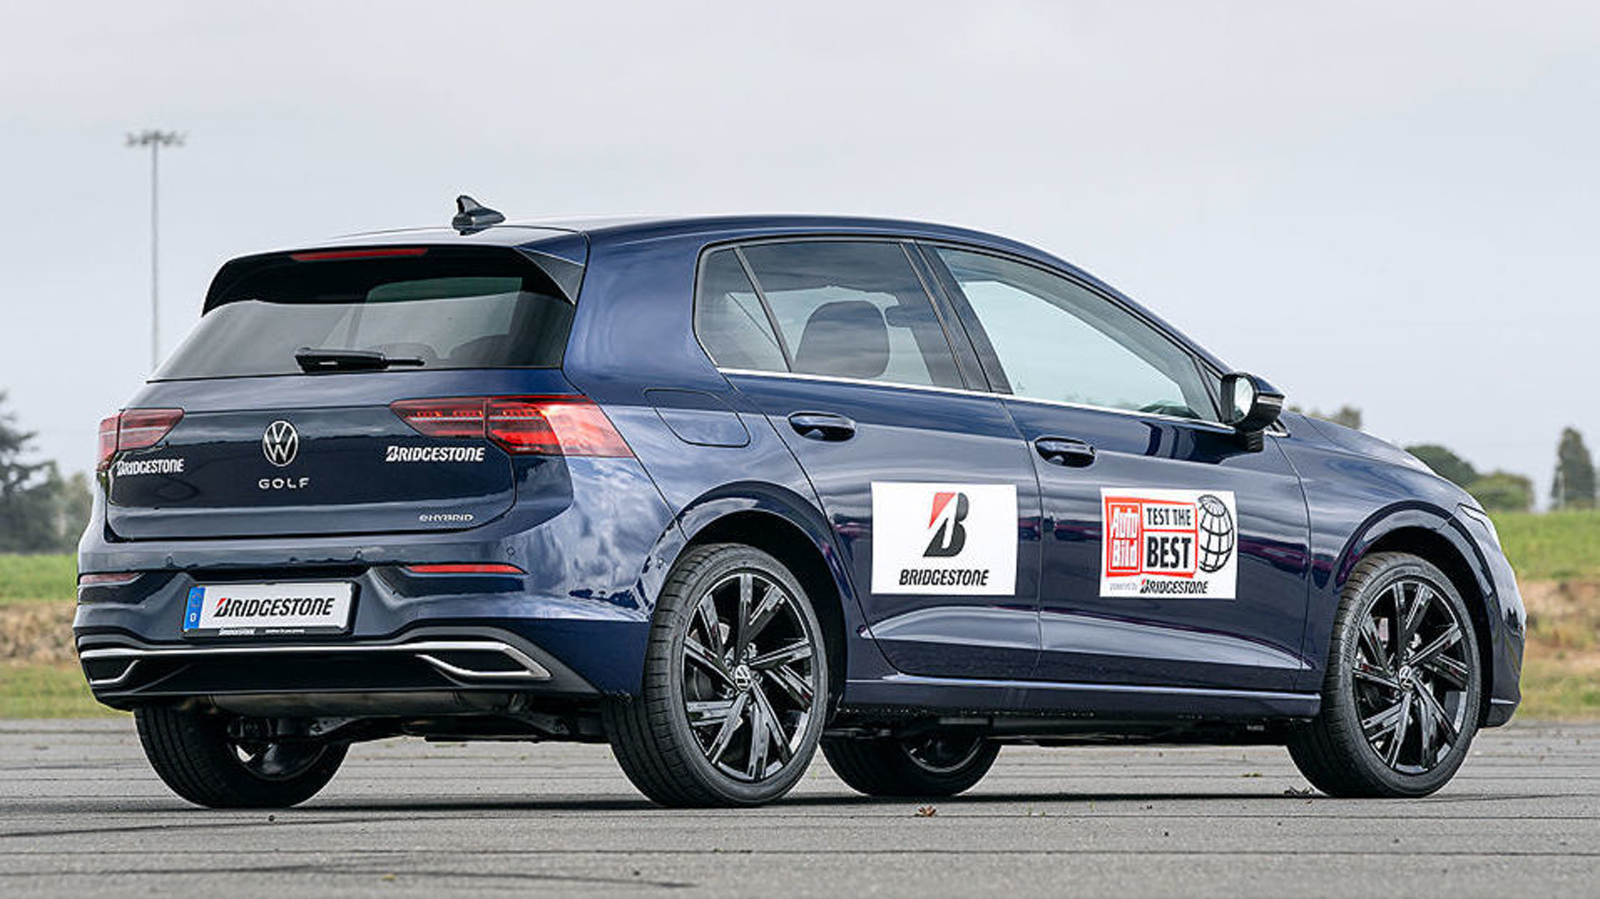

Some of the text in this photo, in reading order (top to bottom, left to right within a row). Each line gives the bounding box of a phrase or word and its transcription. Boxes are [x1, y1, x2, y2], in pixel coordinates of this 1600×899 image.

[385, 445, 485, 462] BRIDGESTONE
[116, 458, 185, 476] BRIDGESTONE
[258, 477, 310, 490] GOLF
[1146, 507, 1191, 526] TEST THE
[1146, 536, 1192, 569] BEST
[899, 569, 990, 586] BRIDGESTONE
[1140, 579, 1208, 594] BRIDGESTONE
[213, 597, 335, 618] BRIDGESTONE
